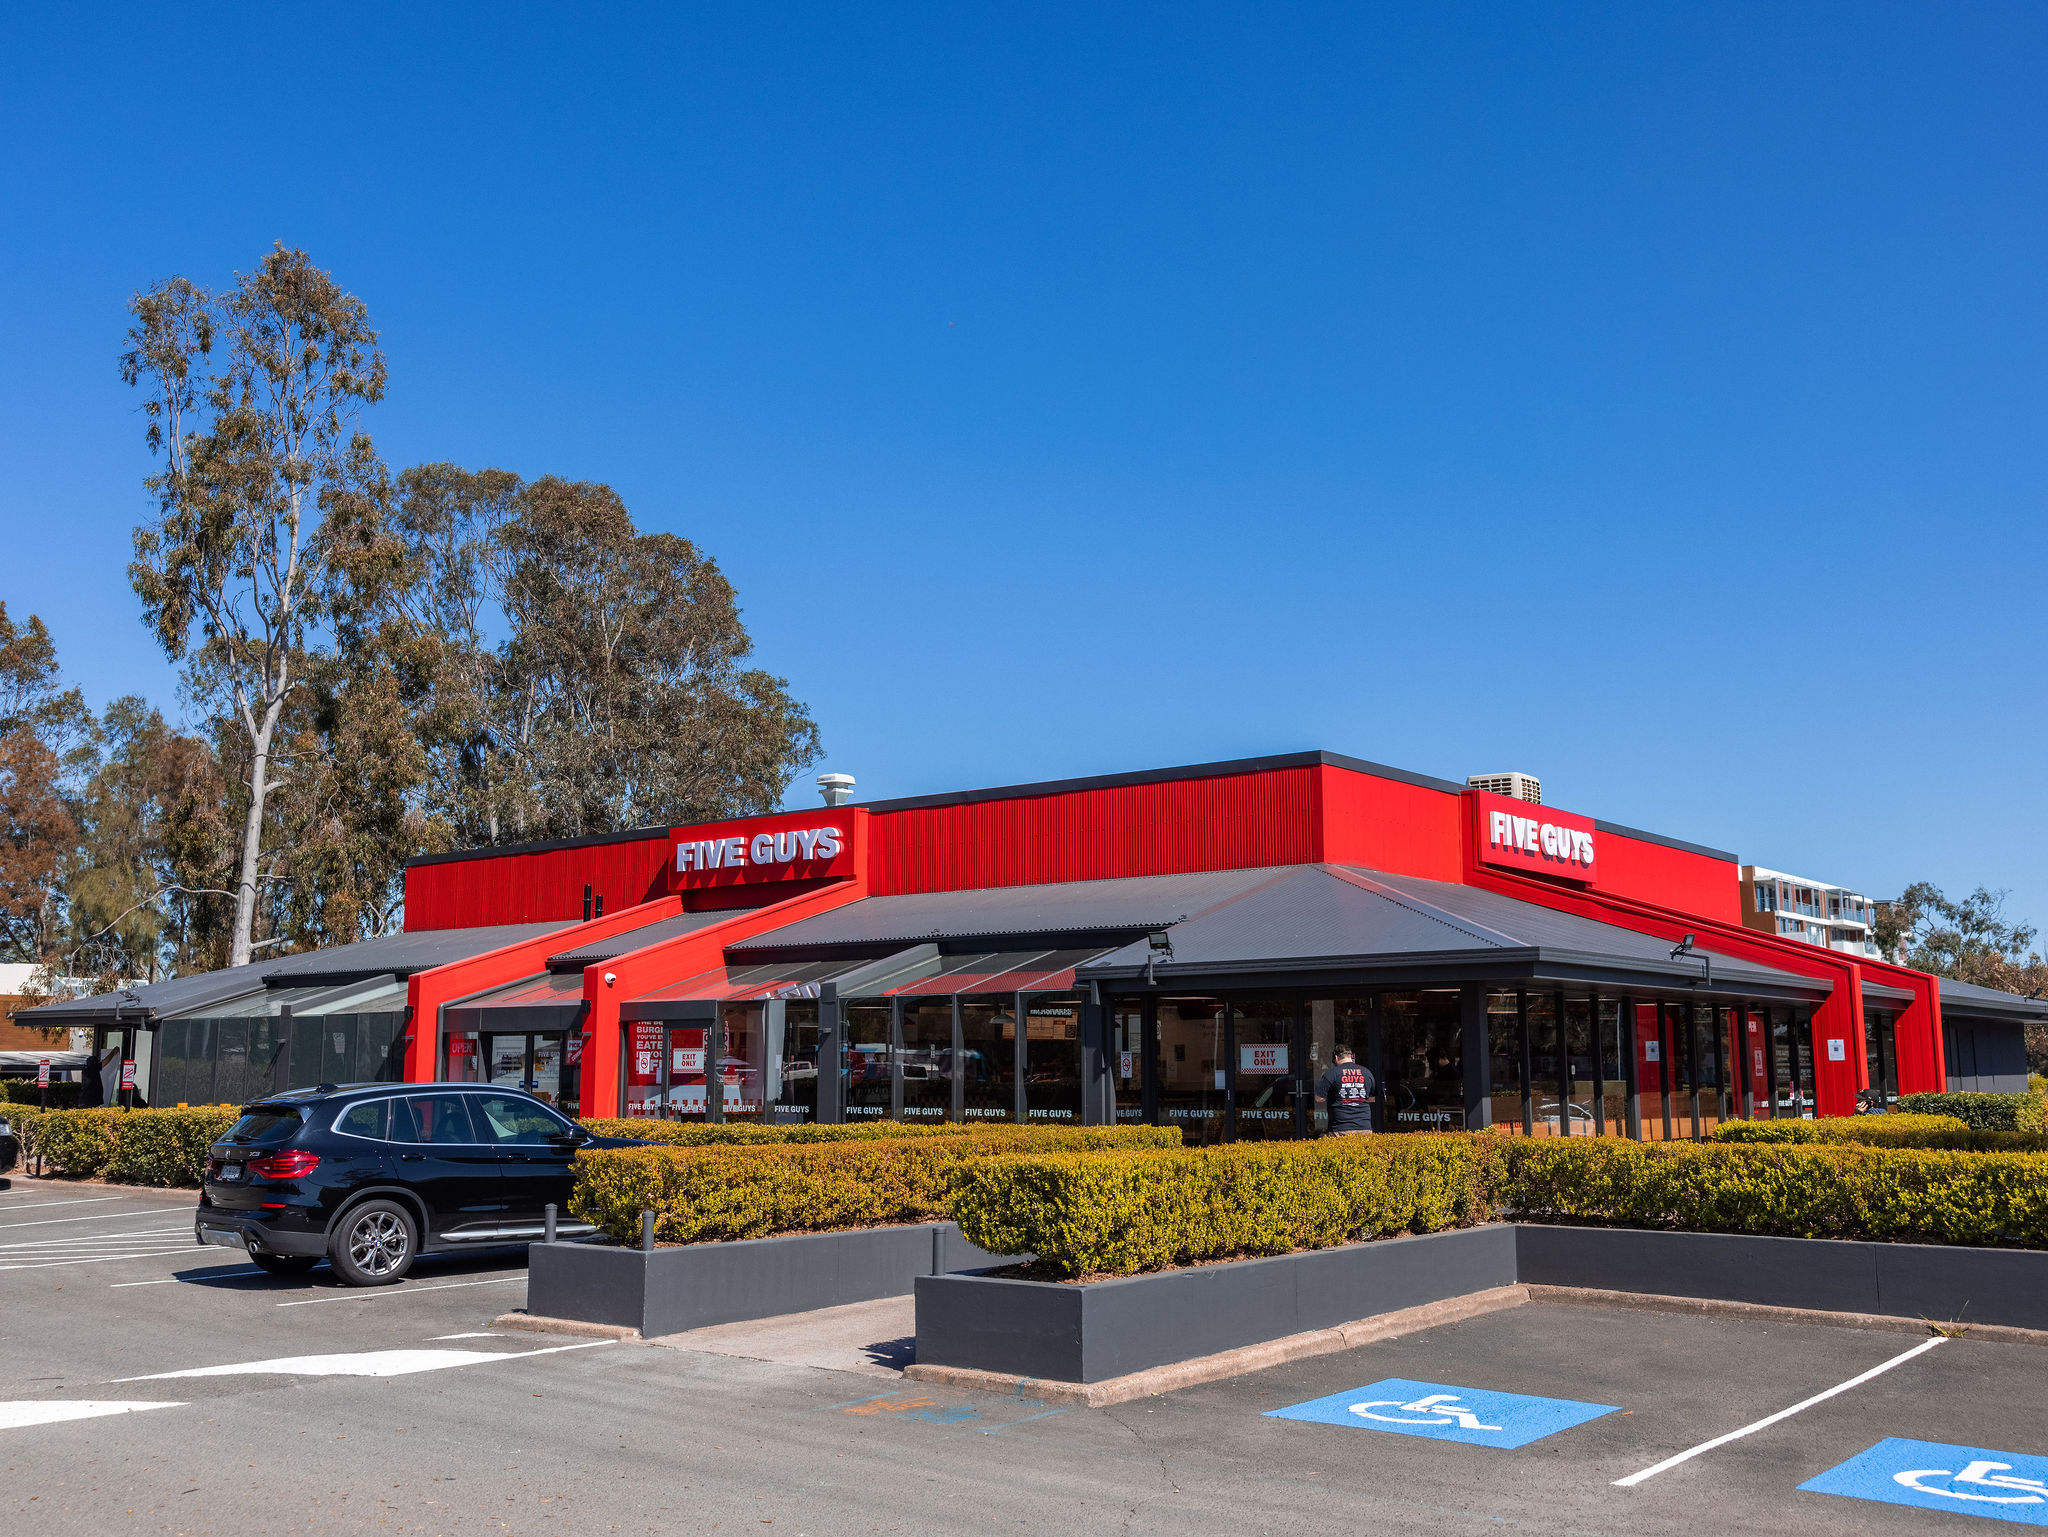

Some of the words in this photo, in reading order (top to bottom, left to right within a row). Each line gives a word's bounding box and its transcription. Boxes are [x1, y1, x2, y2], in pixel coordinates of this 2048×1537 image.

[1490, 811, 1539, 851] FIVE
[1540, 823, 1594, 863] GUYS
[677, 837, 746, 872] FIVE
[751, 827, 841, 865] GUYS
[636, 1026, 664, 1034] BURG
[451, 1041, 473, 1054] OPEN
[636, 1041, 663, 1050] EATE
[1254, 1050, 1276, 1058] EXIT
[1253, 1058, 1277, 1066] ONLY
[1342, 1068, 1362, 1076] FIVE
[1341, 1075, 1365, 1083] GUYS
[567, 1102, 580, 1110] FIVE
[628, 1103, 642, 1111] FIVE
[774, 1105, 790, 1113] FIVE
[846, 1106, 862, 1114] FIVE
[863, 1107, 884, 1115] GUYS
[904, 1107, 921, 1115] FIVE
[922, 1108, 944, 1116] GUYS
[965, 1108, 983, 1116] FIVE
[984, 1109, 1006, 1117] GUYS
[1029, 1109, 1048, 1117] FIVE
[1049, 1109, 1073, 1118] GUYS
[1125, 1109, 1143, 1117] GUYS
[1169, 1109, 1188, 1117] FIVE
[1190, 1109, 1214, 1118] GUYS
[1241, 1110, 1262, 1118] FIVE
[1264, 1111, 1290, 1119] GUYS
[1313, 1111, 1328, 1120] FIV
[1398, 1112, 1420, 1121] FIVE
[1422, 1113, 1451, 1122] GUYS
